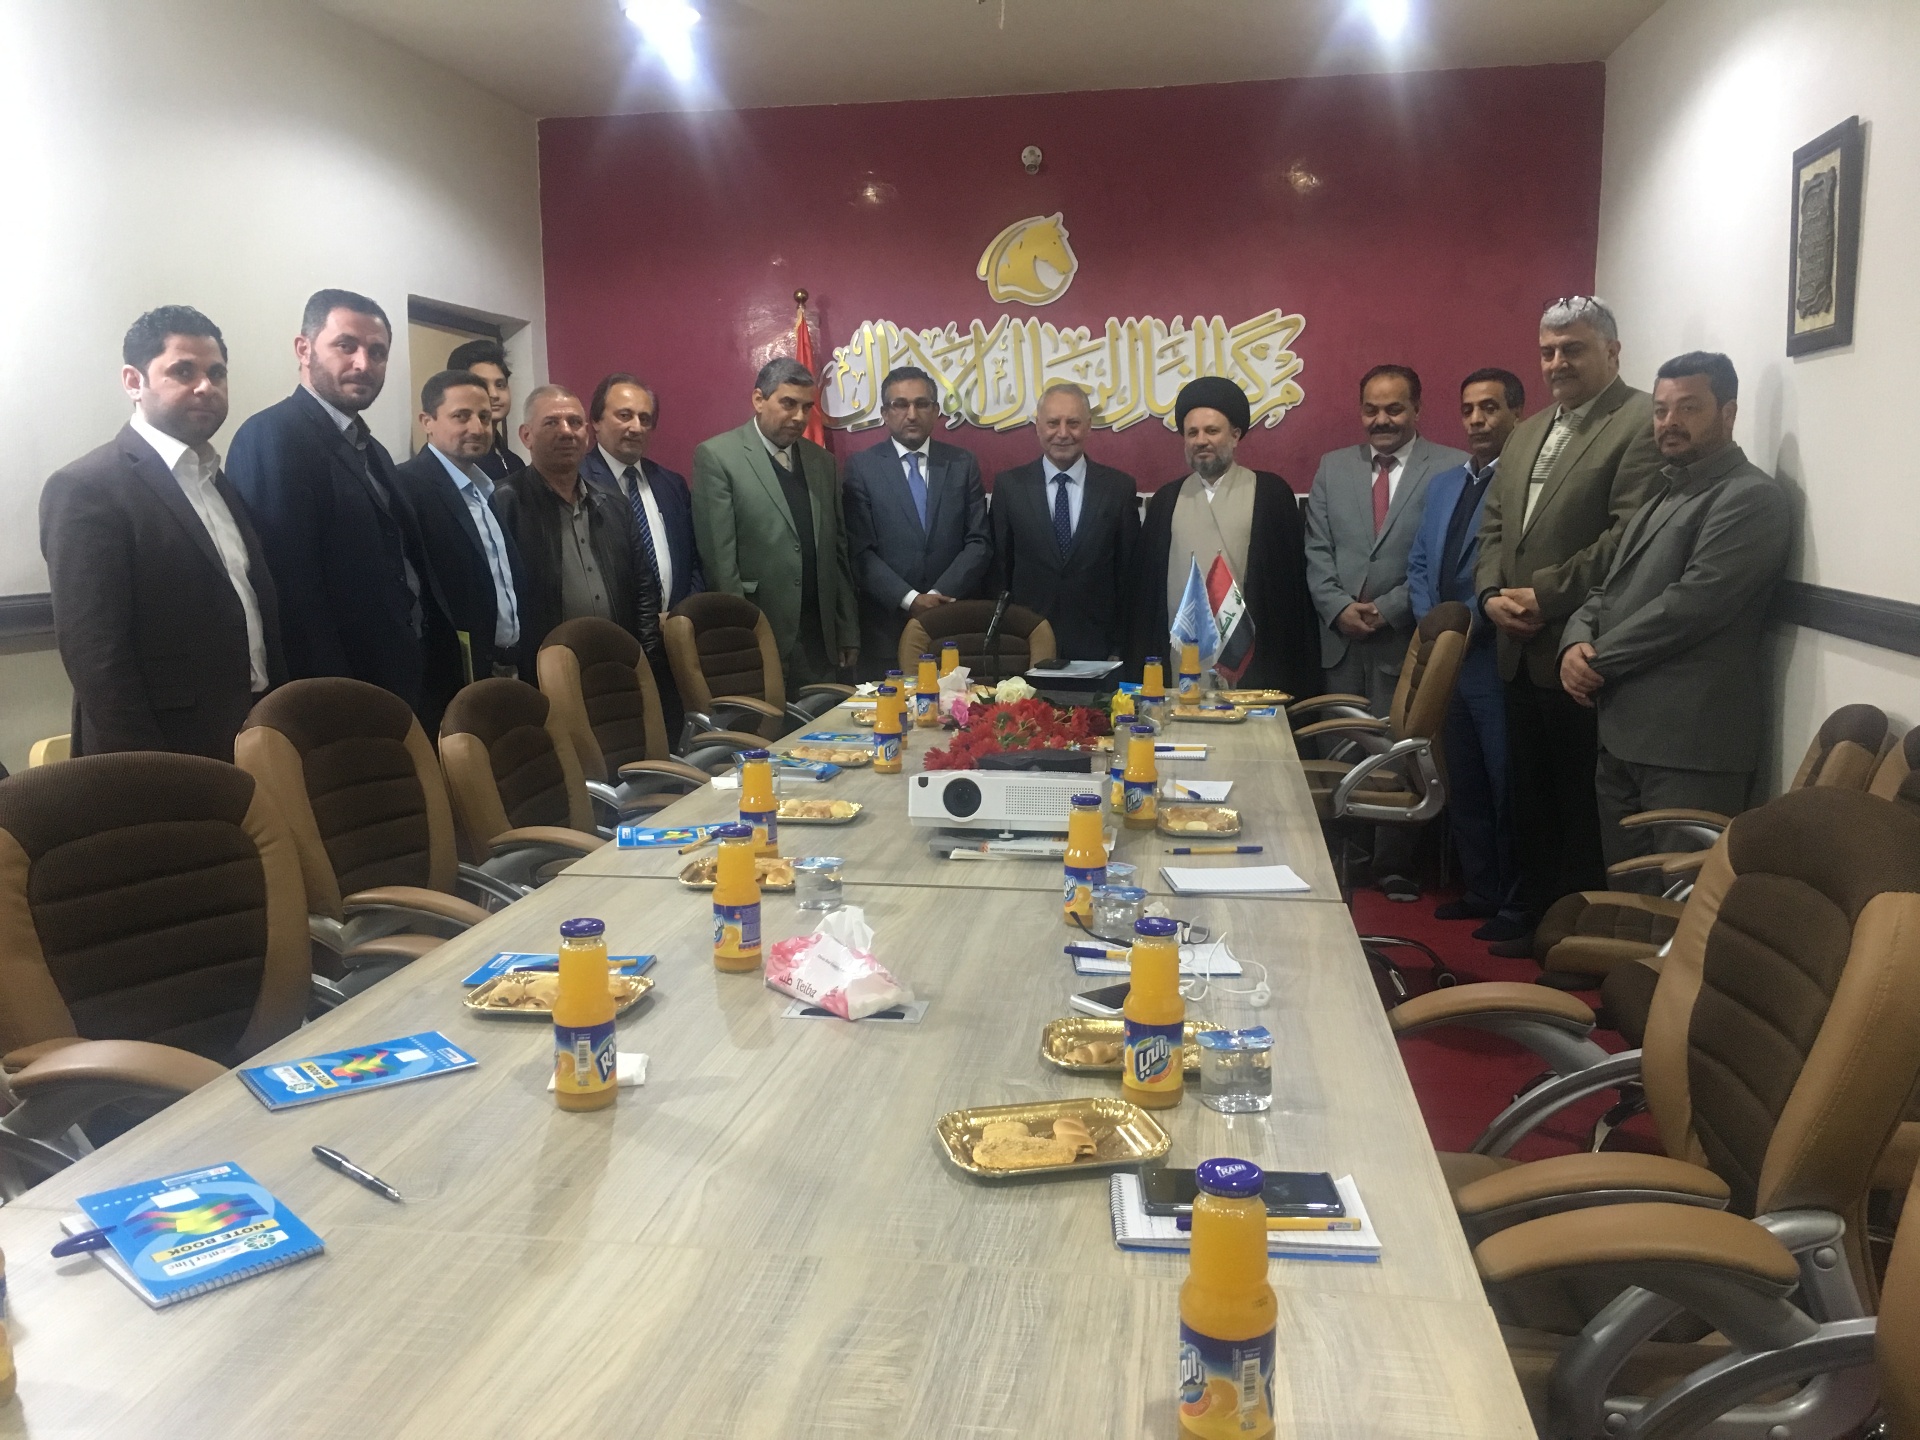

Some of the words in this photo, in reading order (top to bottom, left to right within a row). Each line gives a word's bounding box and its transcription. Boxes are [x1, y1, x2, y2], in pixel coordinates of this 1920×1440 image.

[822, 314, 1009, 430] الاال
[796, 977, 818, 998] Teiba
[600, 1043, 616, 1076] RA
[1139, 1038, 1169, 1079] راني
[1219, 1163, 1248, 1176] RANI
[218, 1222, 267, 1241] NOTE
[165, 1237, 217, 1257] BOOK
[1180, 1350, 1204, 1398] ران
